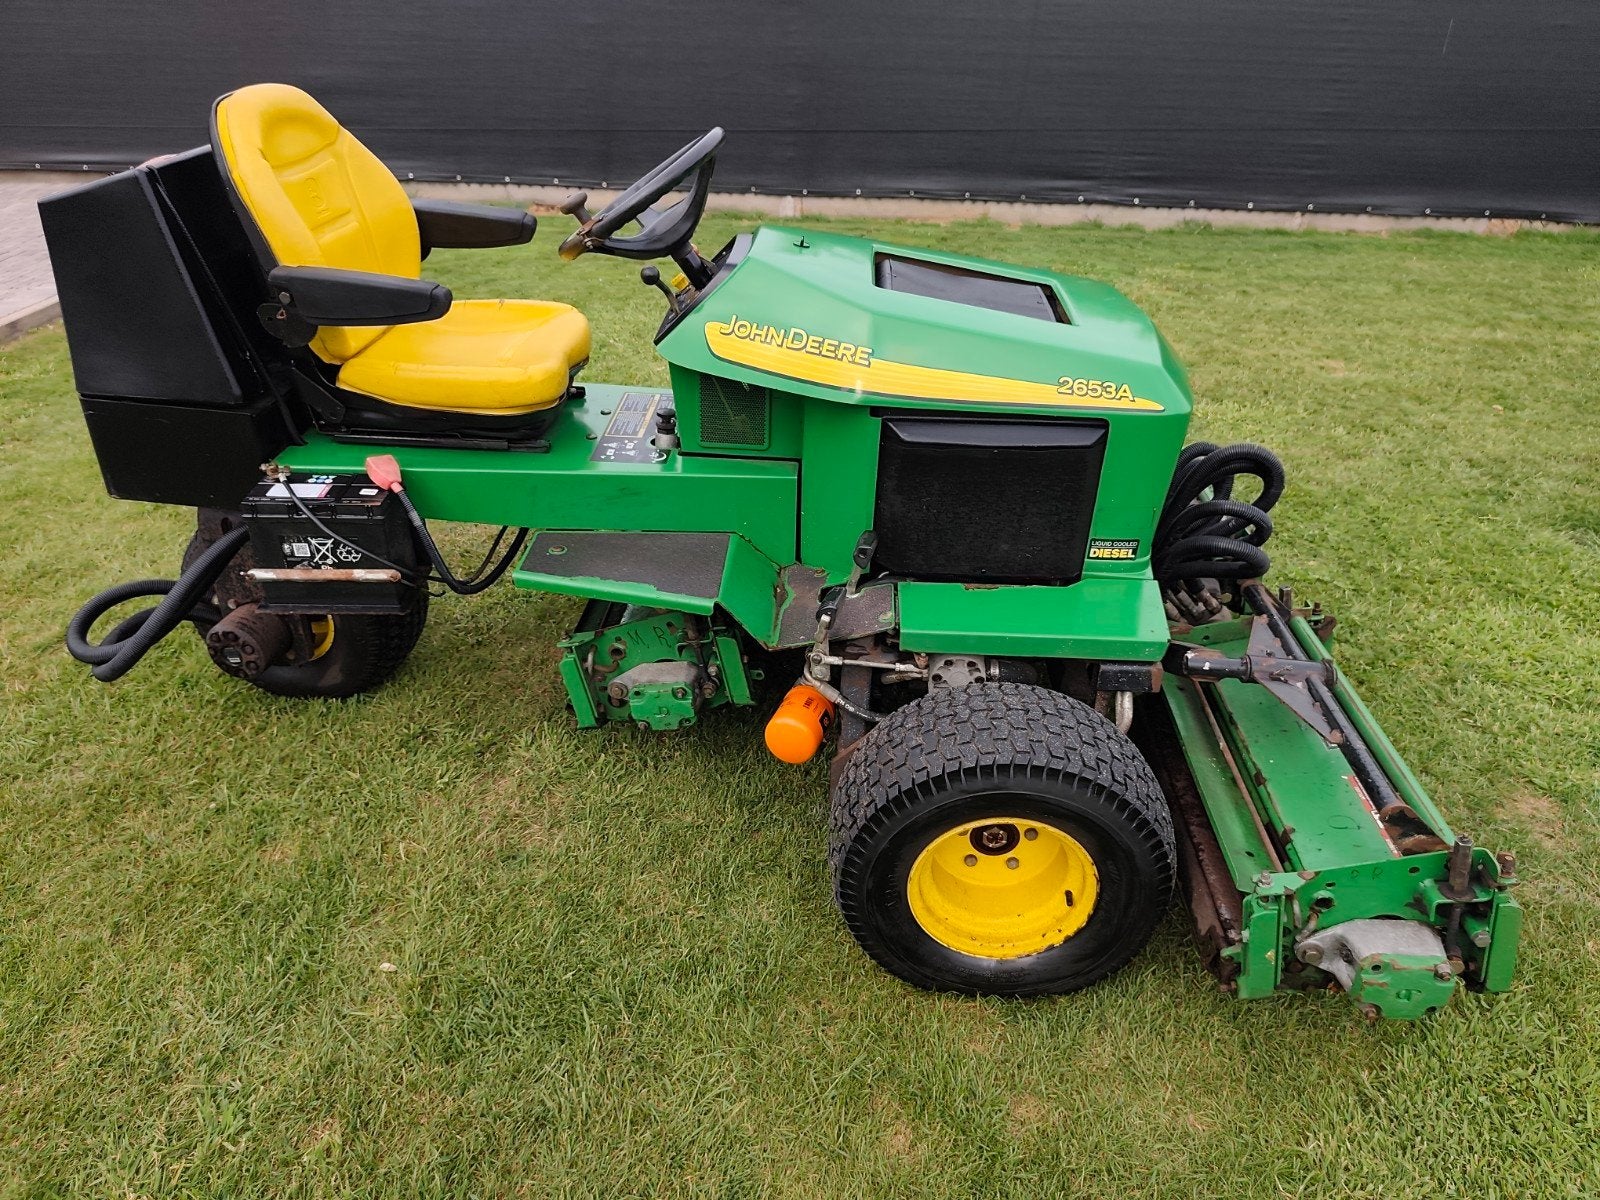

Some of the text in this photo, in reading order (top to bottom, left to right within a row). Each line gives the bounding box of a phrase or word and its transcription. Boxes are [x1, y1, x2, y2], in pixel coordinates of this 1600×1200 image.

[719, 314, 873, 368] JOHN DEERE
[1057, 375, 1135, 403] 2653A
[1089, 548, 1135, 558] DIESEL
